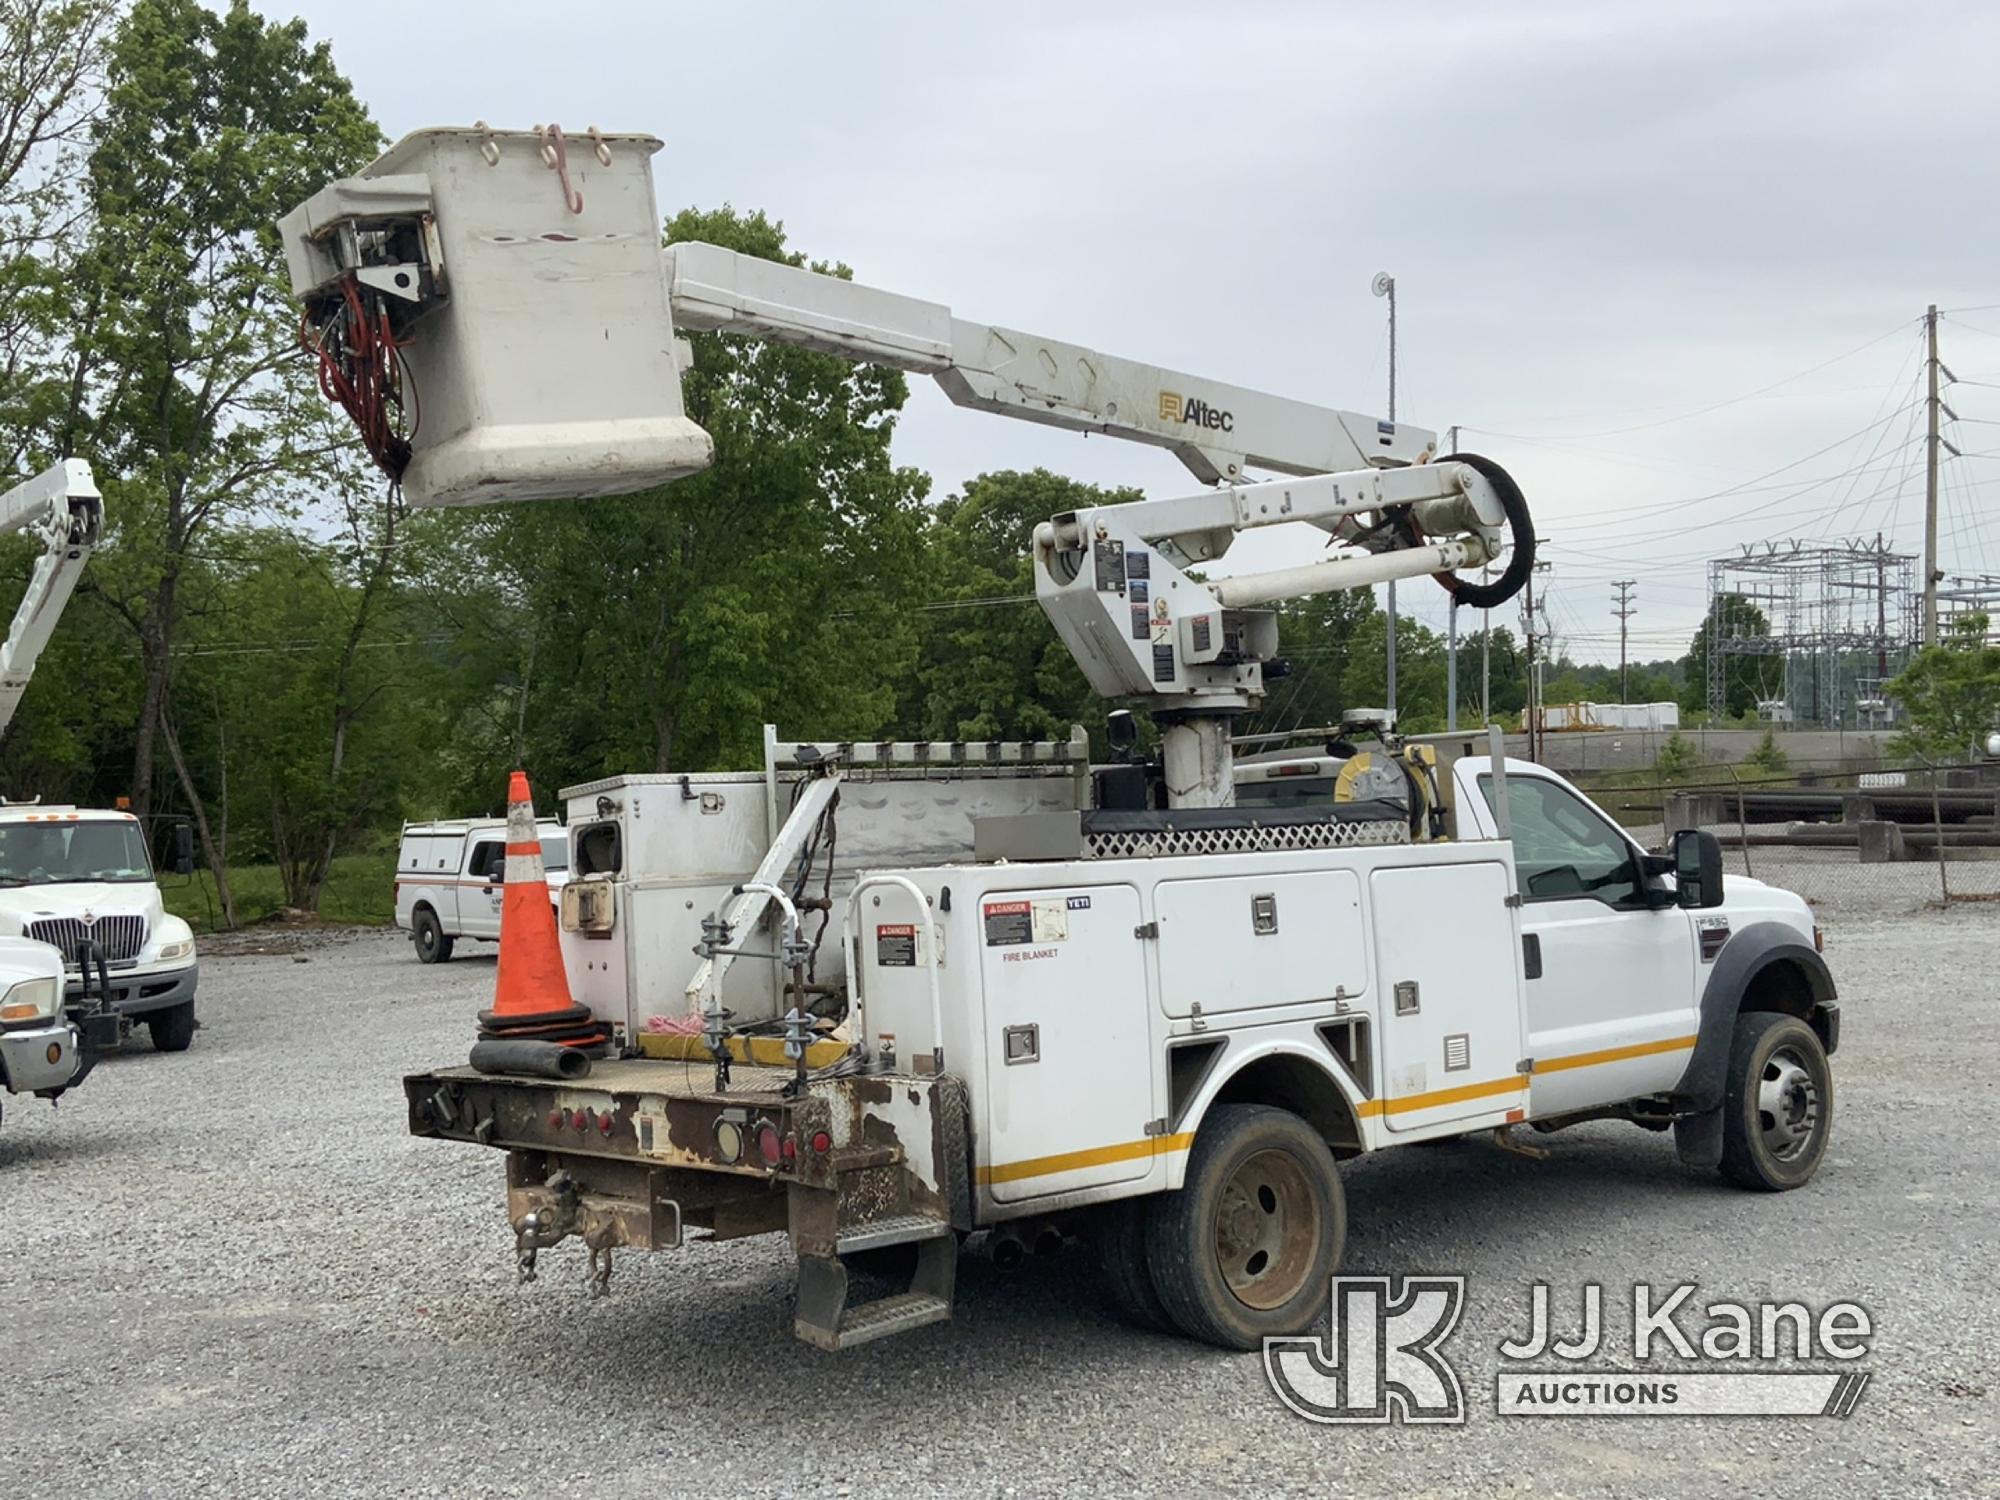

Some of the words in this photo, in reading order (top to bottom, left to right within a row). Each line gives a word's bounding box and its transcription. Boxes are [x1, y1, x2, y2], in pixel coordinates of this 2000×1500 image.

[1183, 398, 1233, 432] Altec
[997, 903, 1027, 913] DANGER
[1068, 899, 1090, 909] YETI
[886, 926, 912, 935] DANGER
[1003, 952, 1021, 962] FIRE
[1022, 948, 1058, 960] BLANKET
